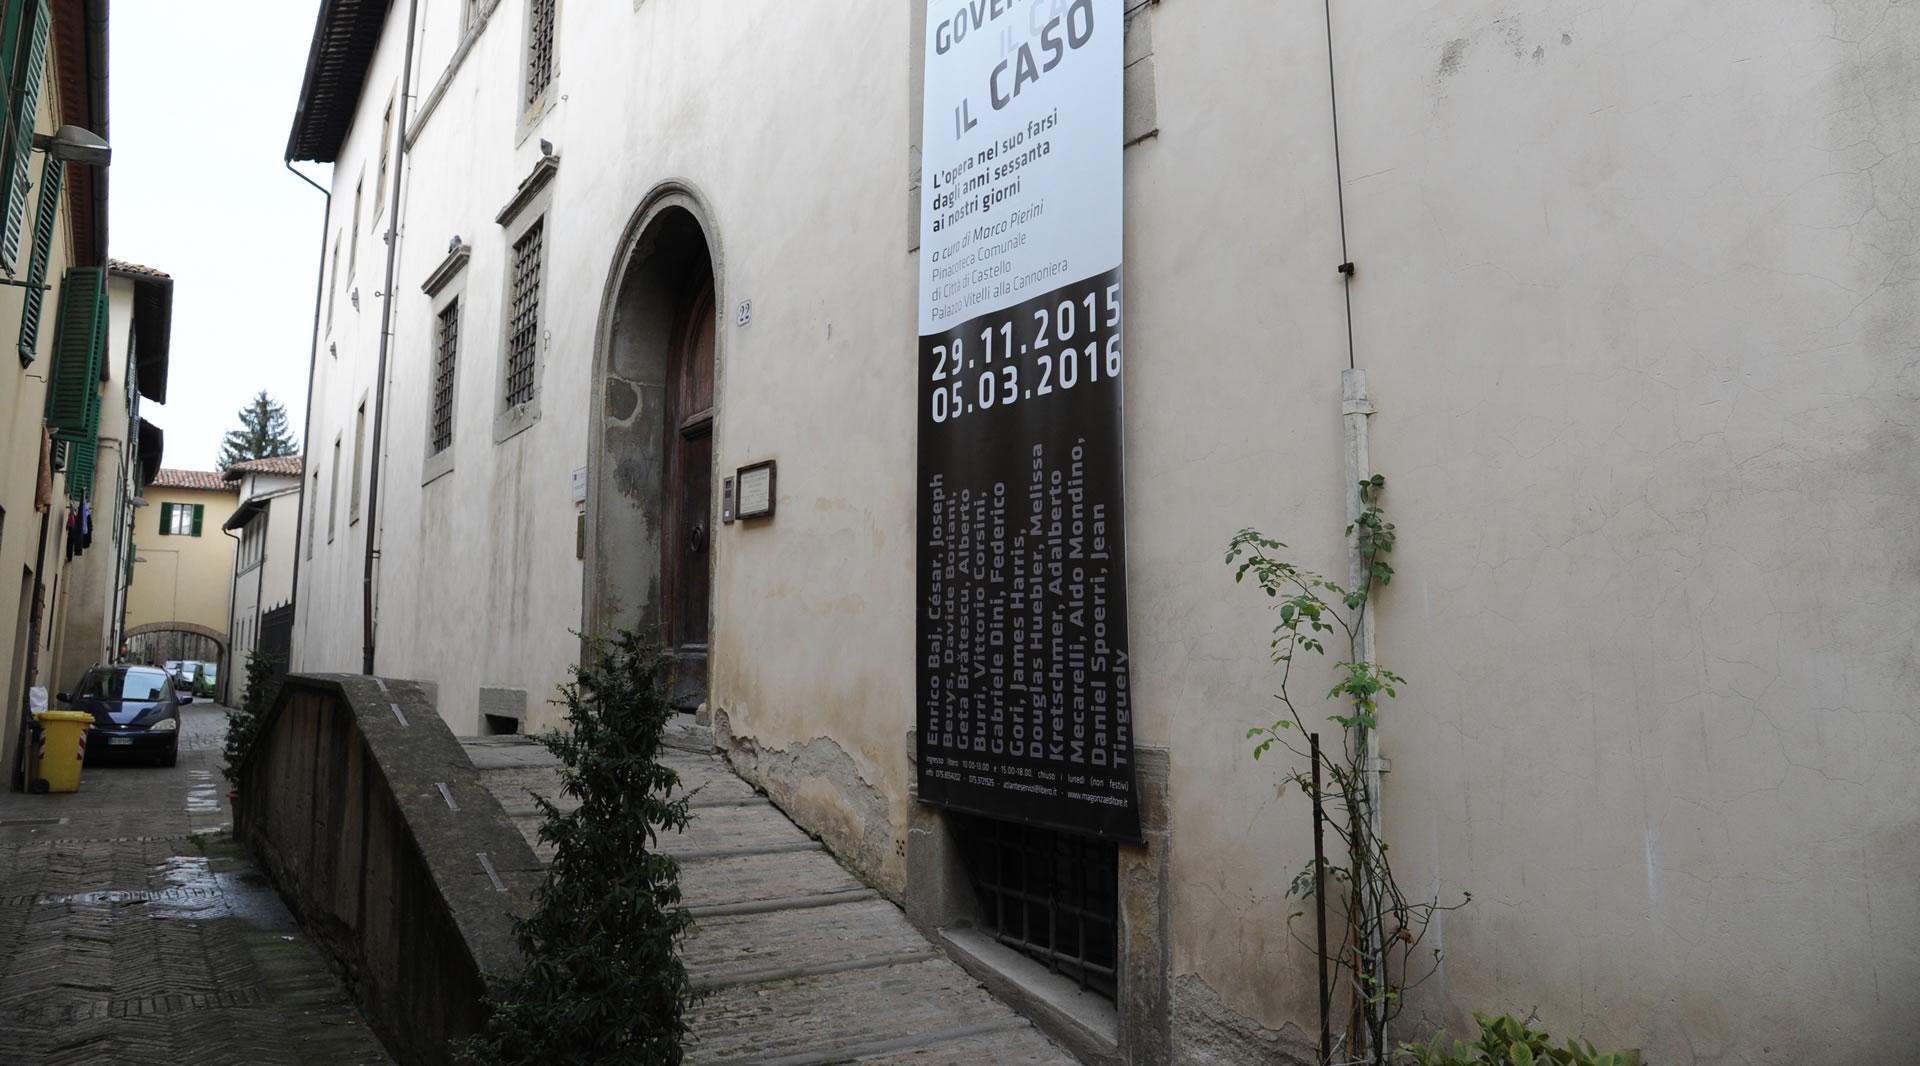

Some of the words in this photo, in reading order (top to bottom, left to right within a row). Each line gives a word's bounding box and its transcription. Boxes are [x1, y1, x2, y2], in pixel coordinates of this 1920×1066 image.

[955, 98, 977, 141] IL
[990, 0, 1094, 110] CASO
[933, 157, 974, 188] L'opera
[978, 140, 998, 165] nel
[1002, 130, 1023, 153] suo
[1027, 107, 1057, 138] farsi
[933, 183, 960, 210] dagli
[963, 167, 990, 194] anni
[994, 140, 1050, 180] sessanta
[932, 251, 939, 262] a
[942, 240, 960, 259] cura
[962, 231, 970, 248] di
[973, 220, 1007, 243] Marco
[1010, 198, 1044, 229] Pierini
[933, 213, 944, 232] ai
[948, 194, 978, 226] nostri
[982, 175, 1020, 212] giorni
[932, 254, 975, 281] Pinacoteca
[977, 232, 1026, 261] Comunale
[932, 287, 941, 301] di
[963, 273, 970, 289] di
[971, 261, 1011, 284] Castello
[932, 300, 962, 320] Palazzo
[964, 286, 990, 307] Vitelli
[993, 280, 1011, 298] alla
[1013, 259, 1068, 291] Cannoniera
[740, 303, 750, 322] 22
[932, 283, 1120, 381] 29.11.2015
[932, 334, 1121, 422] 05.03.2016
[930, 474, 945, 546] Joseph
[1030, 444, 1042, 535] Melissa
[1068, 438, 1085, 558] Mondino,
[959, 489, 969, 574] Alberto
[974, 492, 987, 579] Corsini,
[990, 483, 1004, 582] Federico
[1011, 529, 1026, 608] Harris,
[1048, 471, 1062, 595] Adalberto
[1091, 504, 1108, 559] Jean
[929, 554, 943, 619] César,
[990, 591, 1006, 645] Dini,
[1030, 544, 1044, 649] Huebler,
[1069, 568, 1083, 627] Aldo
[1090, 568, 1109, 671] Spoerri,
[928, 628, 942, 668] Baj,
[945, 601, 954, 663] Davide
[973, 587, 985, 678] Vittorio
[1010, 617, 1027, 691] James
[927, 676, 939, 745] Enrico
[943, 672, 958, 747] Beuys,
[974, 686, 987, 751] Burri,
[990, 654, 1003, 753] Gabriele
[1030, 658, 1046, 758] Douglas
[1049, 604, 1065, 760] Kretschmer,
[1069, 636, 1087, 763] Mecarelli,
[1113, 648, 1130, 768] Tinguely
[957, 697, 968, 749] Geta
[1009, 699, 1026, 756] Gori,
[1091, 682, 1106, 765] Daniel
[1090, 776, 1104, 787] (non
